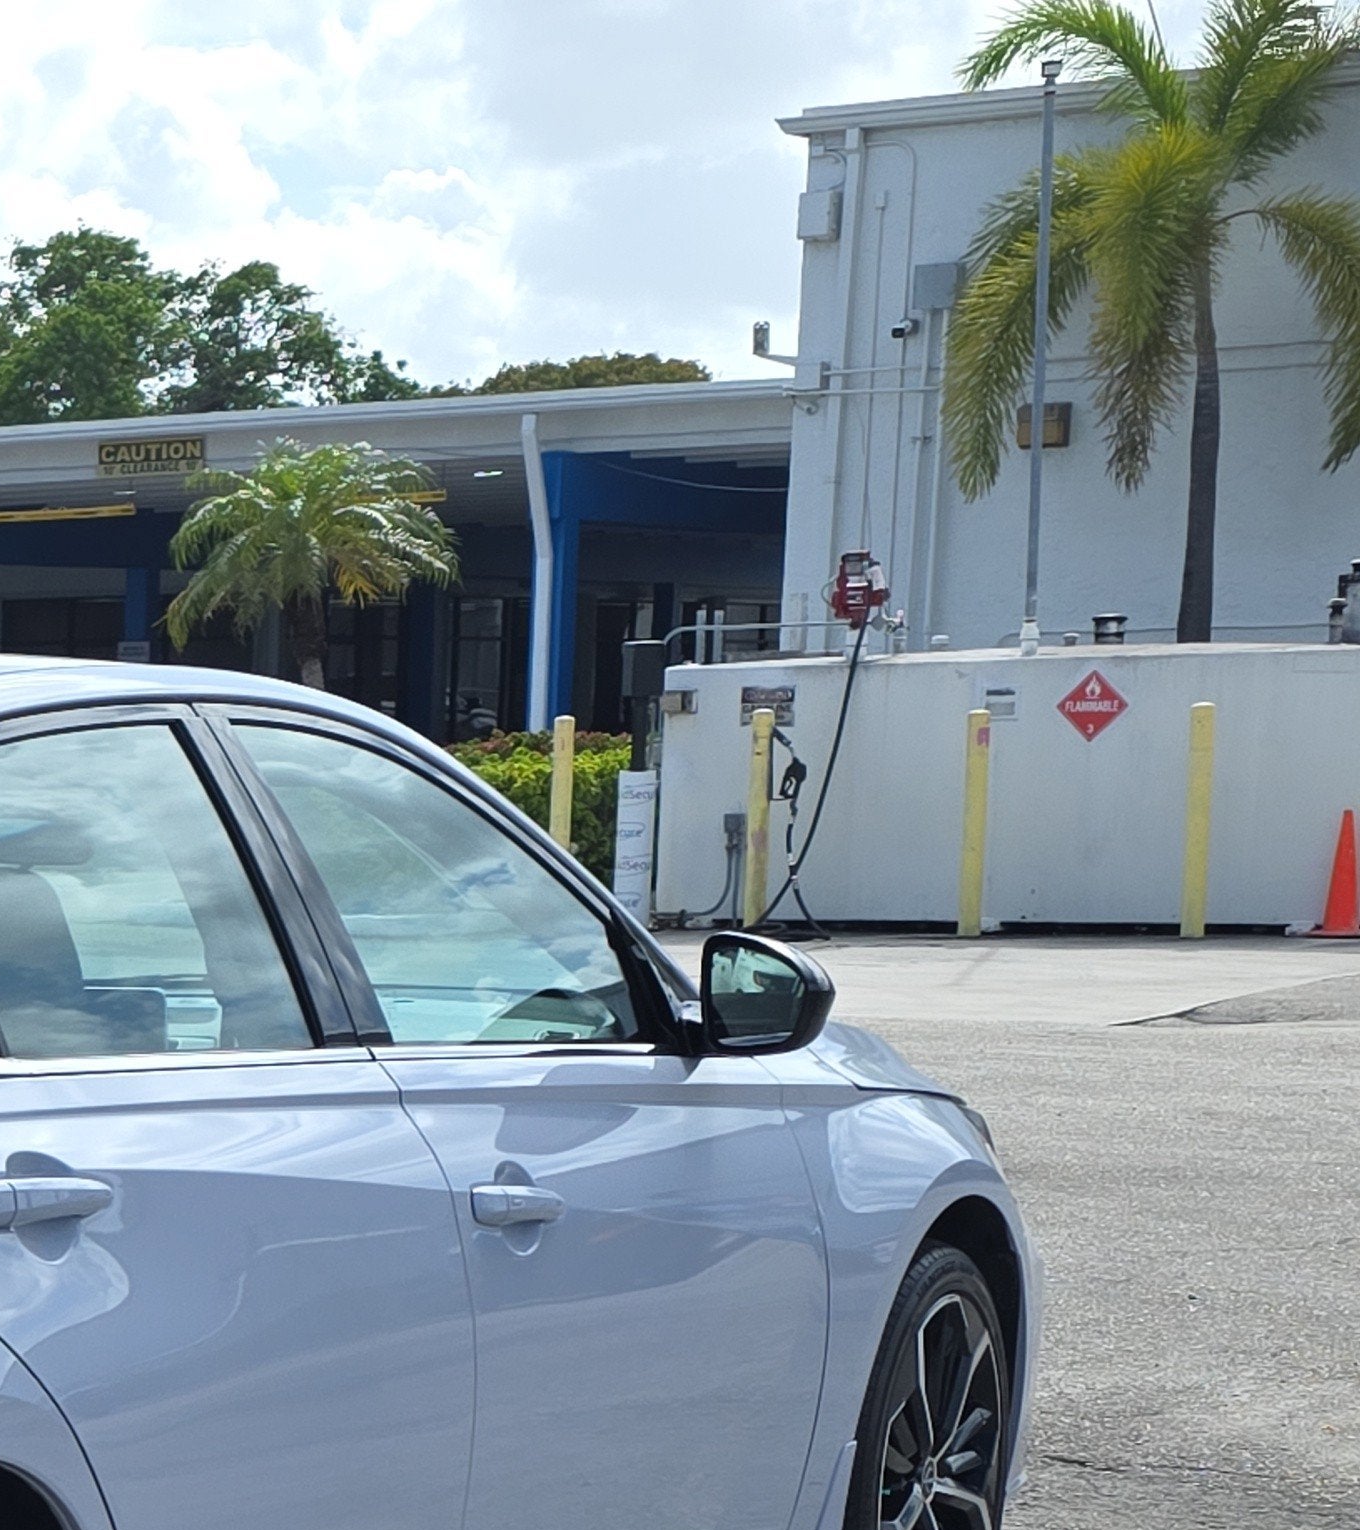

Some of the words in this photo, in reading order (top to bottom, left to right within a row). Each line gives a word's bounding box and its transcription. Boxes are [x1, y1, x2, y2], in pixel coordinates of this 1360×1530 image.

[101, 441, 201, 462] CAUTION
[1064, 700, 1119, 713] FLAMMABLE
[1086, 723, 1095, 734] 3
